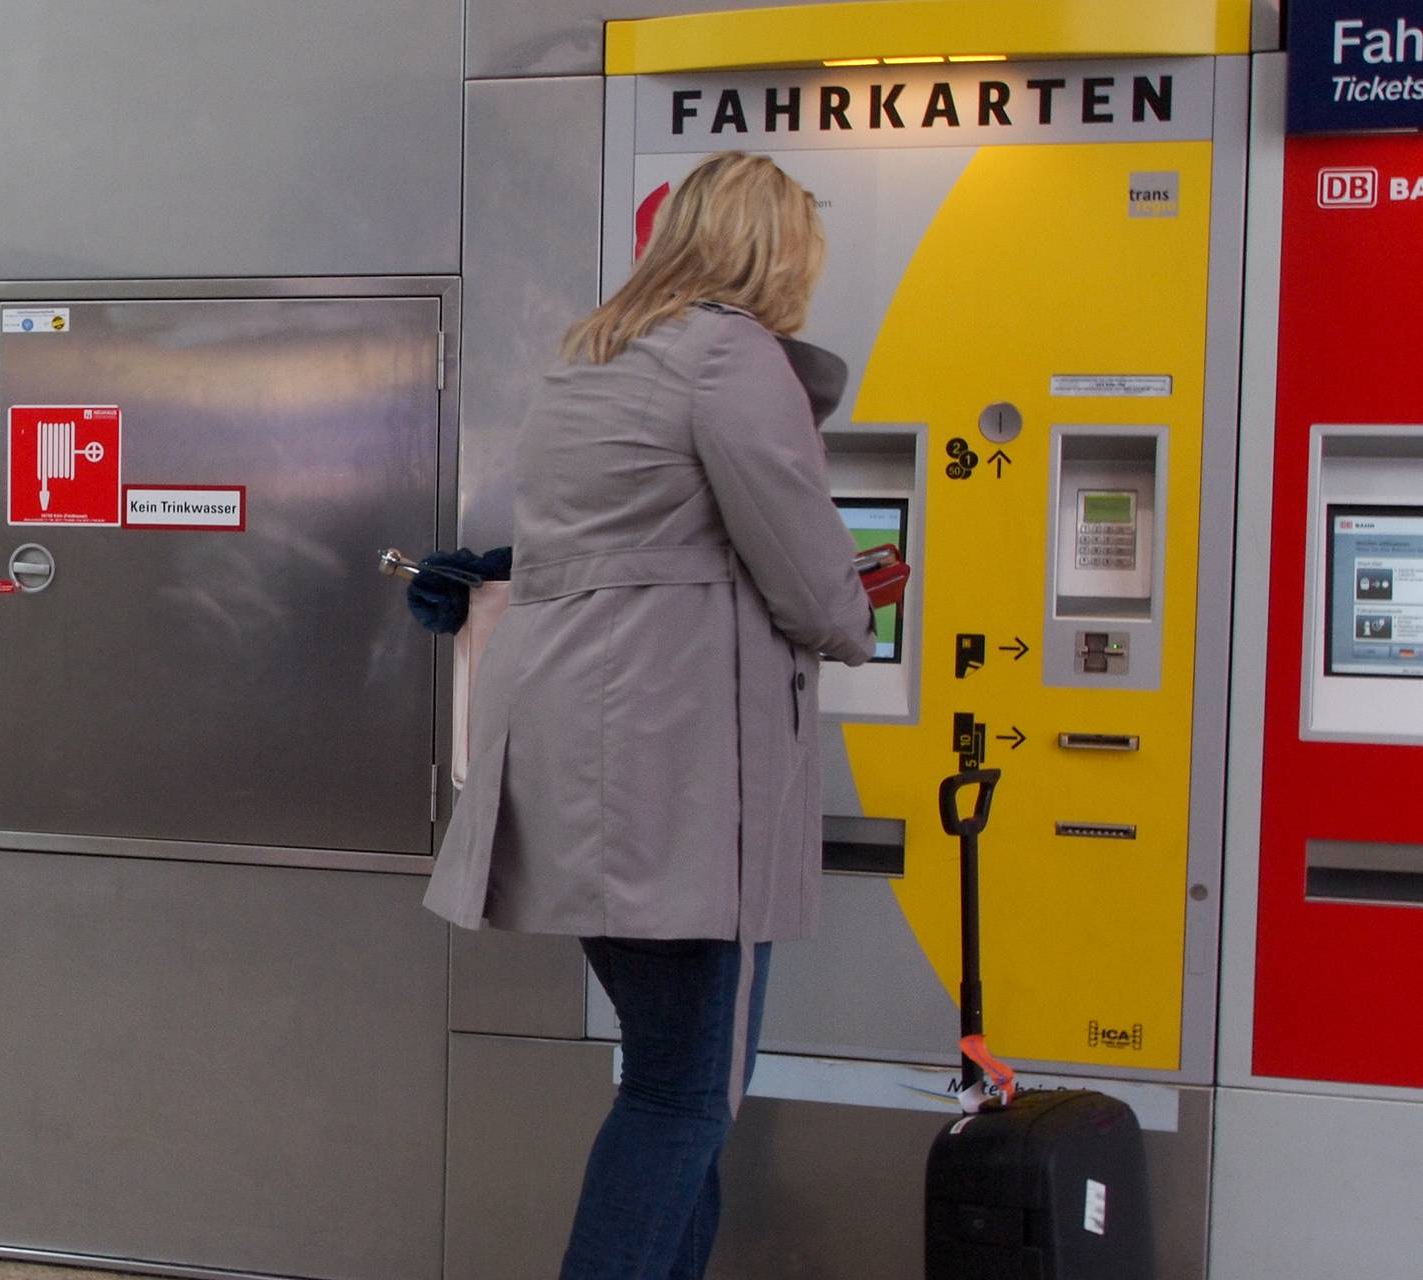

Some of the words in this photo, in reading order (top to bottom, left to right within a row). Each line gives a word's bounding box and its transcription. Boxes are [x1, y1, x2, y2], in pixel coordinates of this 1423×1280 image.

[1333, 18, 1423, 64] Fah
[672, 75, 1173, 135] FAHRKARTEN
[1324, 174, 1372, 202] DB
[1129, 189, 1170, 202] trans
[953, 442, 961, 455] 2
[130, 500, 158, 513] Kein
[160, 501, 237, 514] Trinkwasser
[1101, 1029, 1130, 1041] ICA
